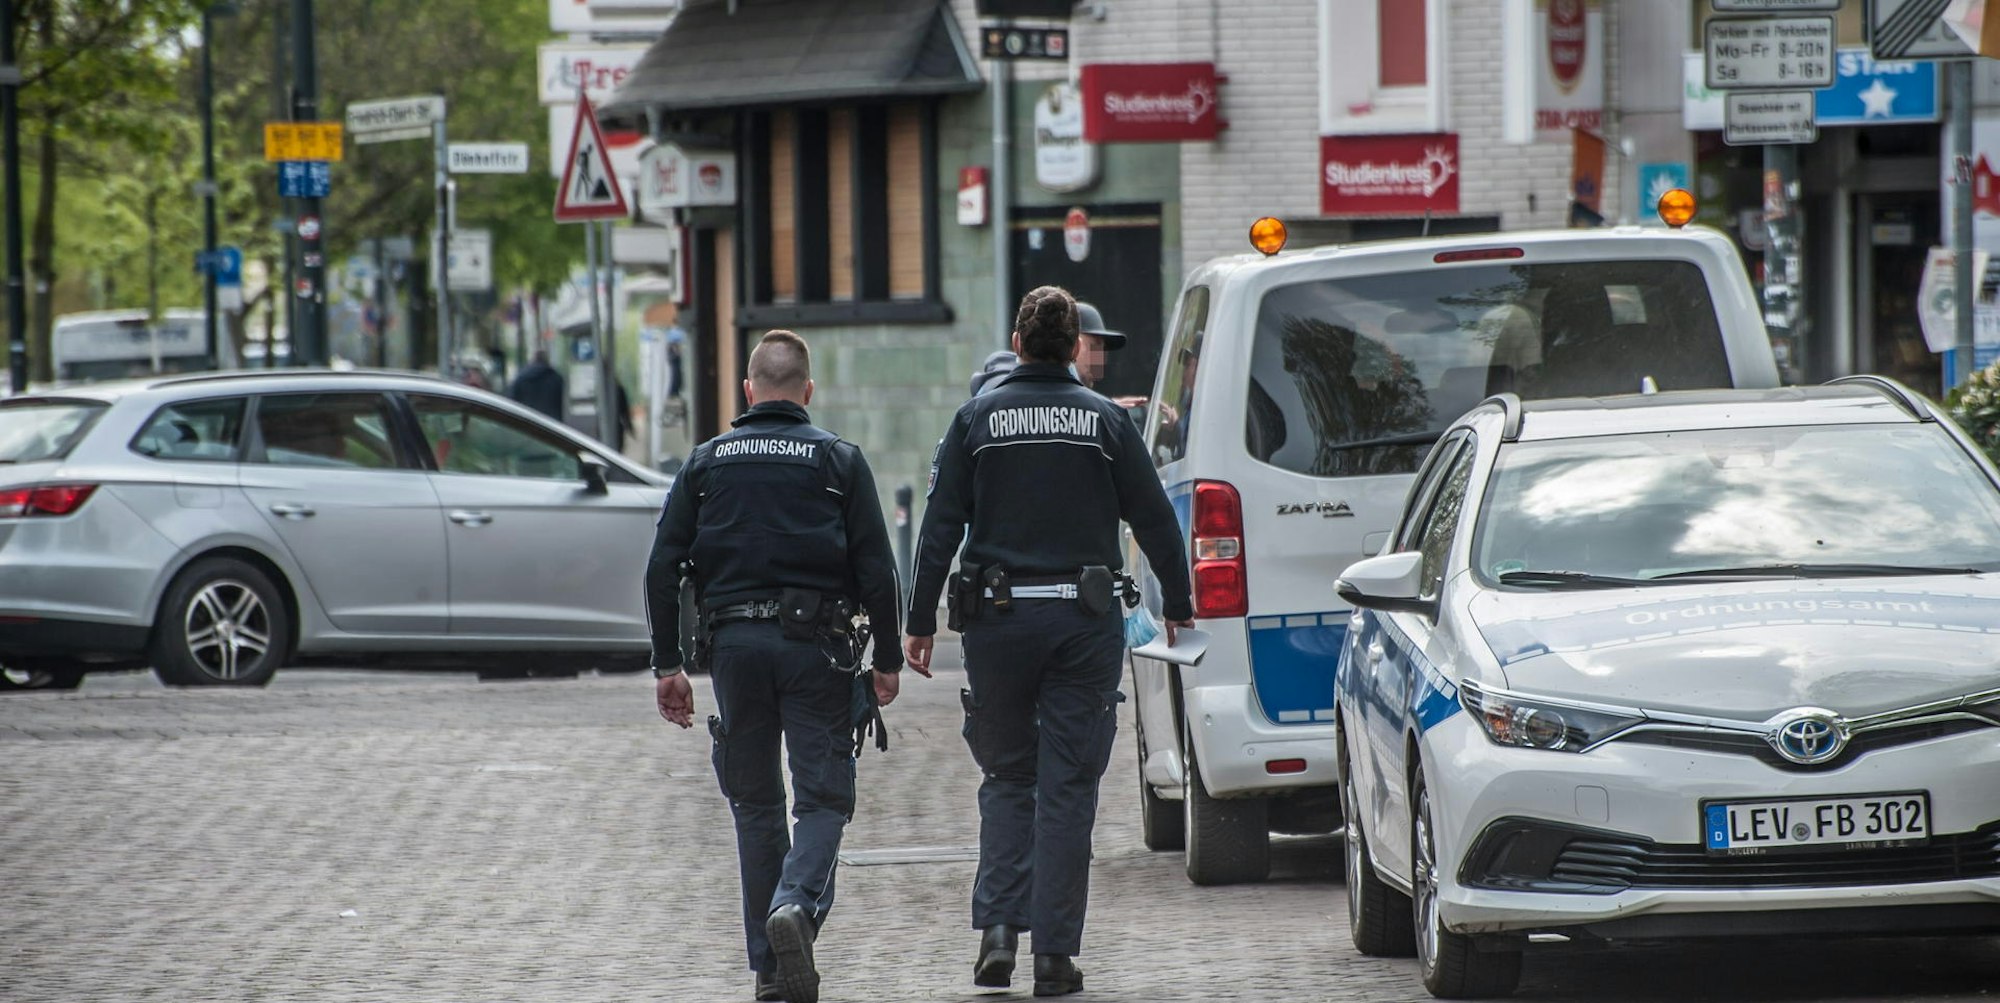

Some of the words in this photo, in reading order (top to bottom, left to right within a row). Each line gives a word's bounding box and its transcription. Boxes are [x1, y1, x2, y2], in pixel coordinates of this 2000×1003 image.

[1716, 43, 1769, 58] Mo-Fr
[1716, 64, 1738, 80] Sa
[1104, 93, 1194, 115] Studienkreis
[1325, 161, 1432, 186] Studienkreis
[988, 406, 1100, 439] ORDNUNGSAMT
[714, 439, 816, 459] ORDNUNGSAMT
[1276, 501, 1351, 515] ZAFIRA
[1624, 599, 1937, 625] Ordnungsamt
[1729, 806, 1789, 842] LEV
[1815, 804, 1856, 838] FB
[1864, 800, 1923, 835] 302
[1714, 831, 1724, 842] D
